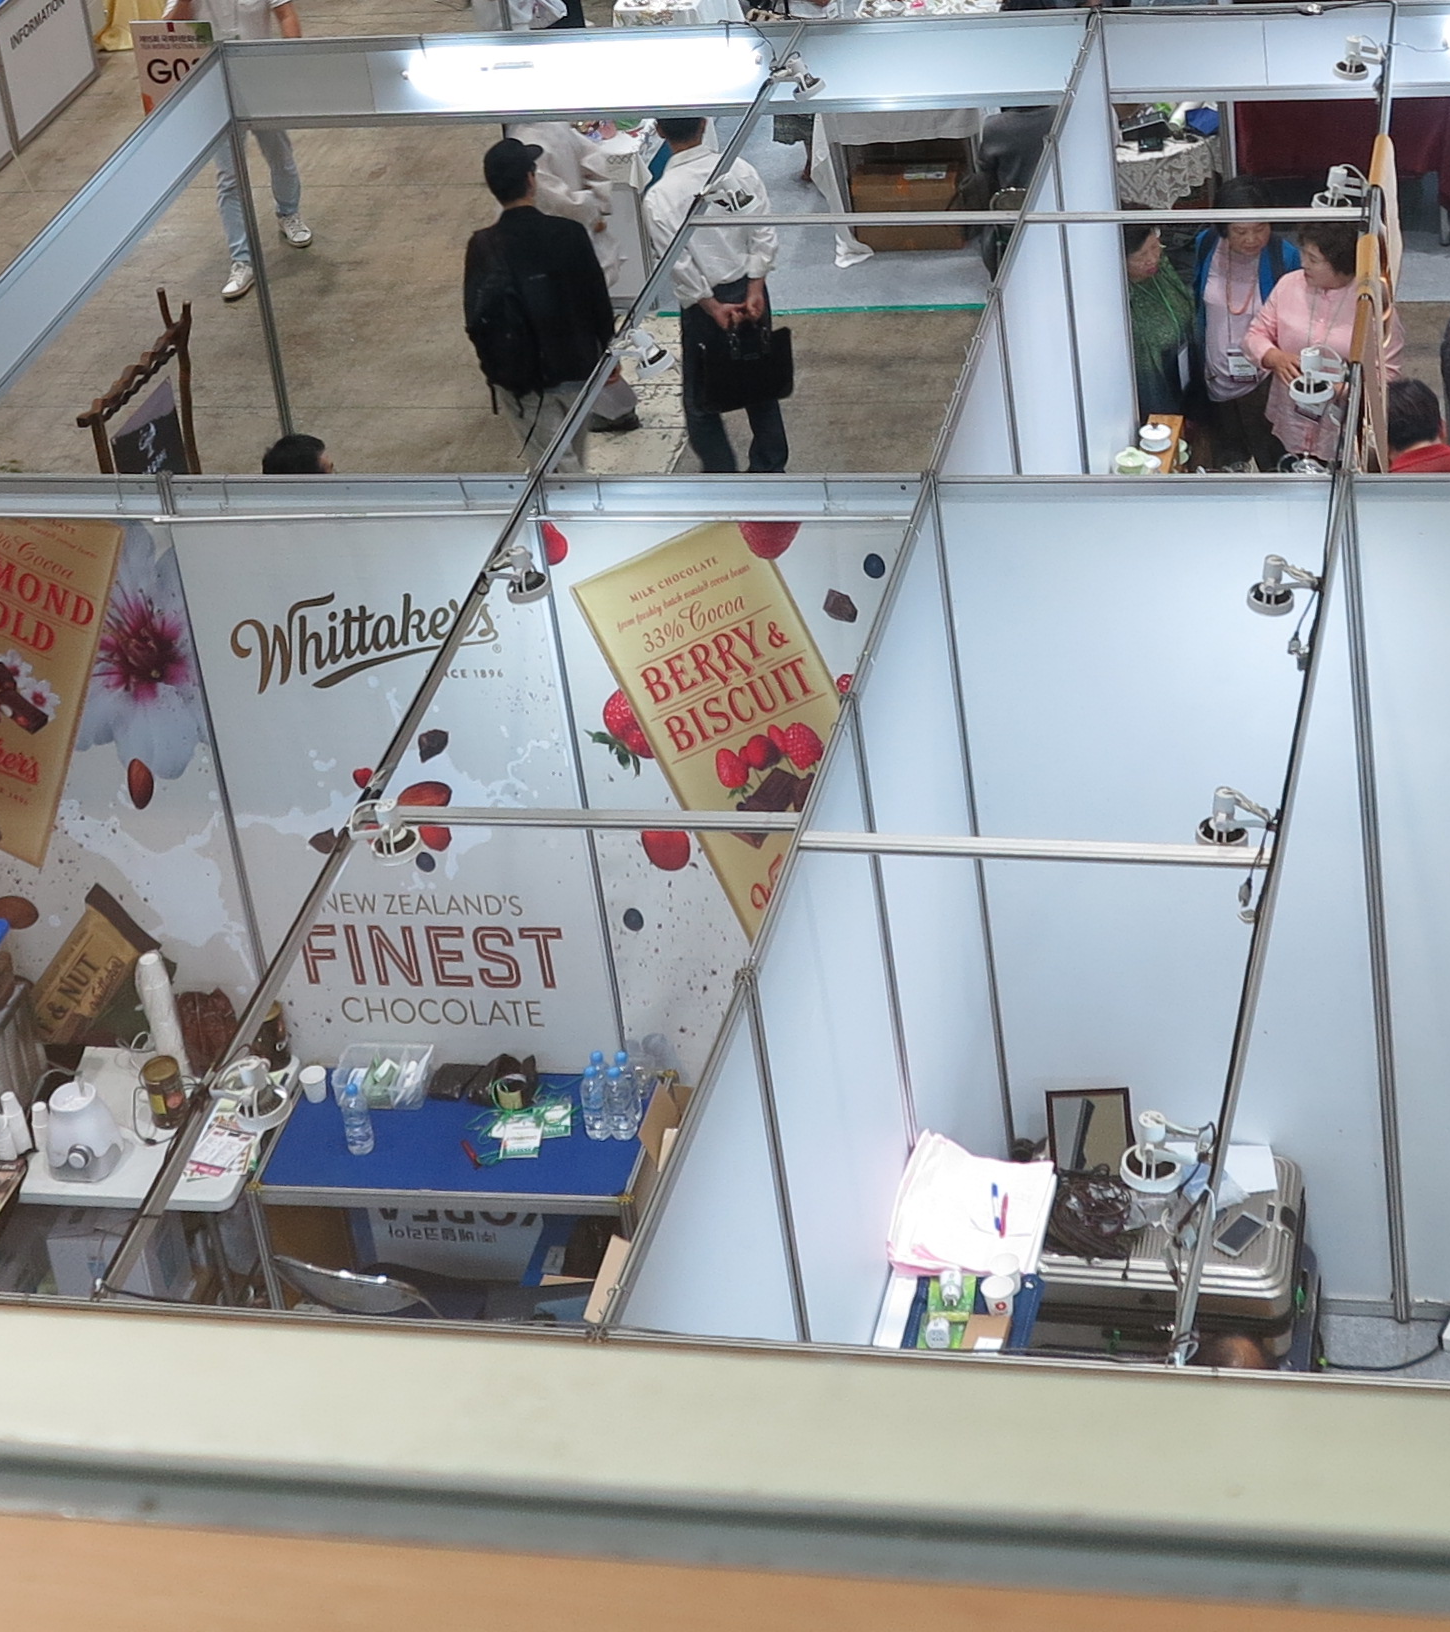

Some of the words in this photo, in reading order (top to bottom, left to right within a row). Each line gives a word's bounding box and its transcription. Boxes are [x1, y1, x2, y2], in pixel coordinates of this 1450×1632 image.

[13, 535, 75, 579] Cocoa
[629, 584, 656, 603] MILK
[657, 556, 719, 590] CHOCOLATE
[642, 619, 685, 654] 33%
[677, 595, 747, 633] Cocoa
[473, 668, 504, 679] 1896
[640, 619, 765, 705] BERRY
[767, 620, 790, 650] &
[663, 656, 816, 753] BISCUIT
[383, 894, 524, 917] ZEALAND'S
[57, 952, 99, 1003] NUT
[301, 924, 563, 990] FINEST
[340, 996, 545, 1028] CHOCOLATE
